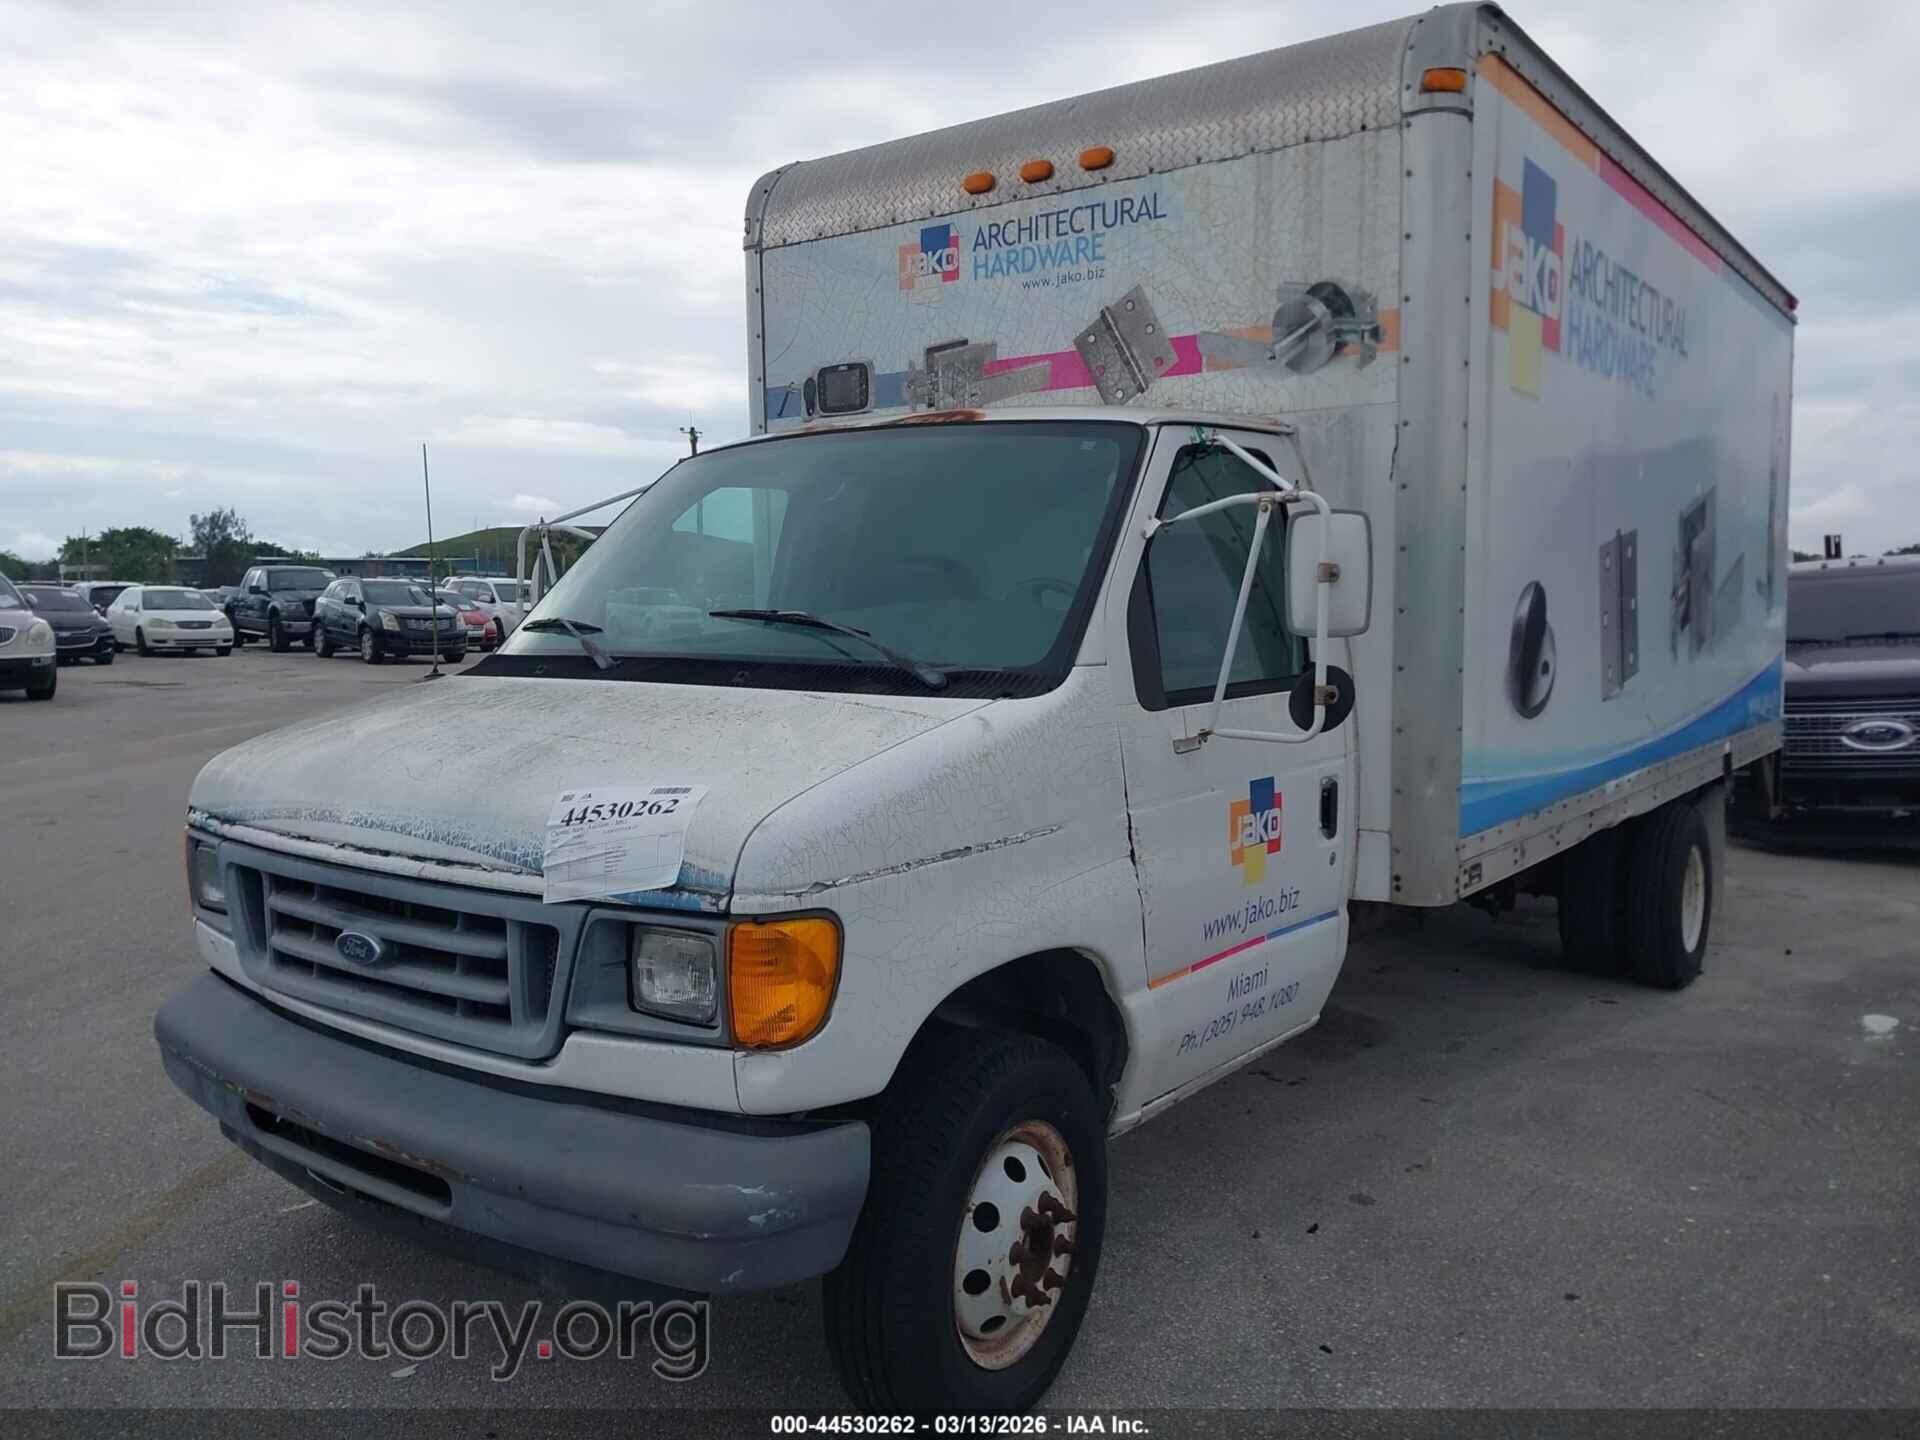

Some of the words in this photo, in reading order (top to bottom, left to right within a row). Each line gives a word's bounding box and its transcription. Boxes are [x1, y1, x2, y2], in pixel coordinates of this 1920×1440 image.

[972, 193, 1167, 252] ARCHITECTURAL
[973, 233, 1106, 281] HARDWARE
[1022, 264, 1105, 290] www.jako.biz
[1569, 234, 1688, 358] ARCHITECTURAL
[560, 799, 680, 828] 44530262
[1203, 886, 1300, 941] www.jako.biz
[1227, 961, 1270, 1003] Miami
